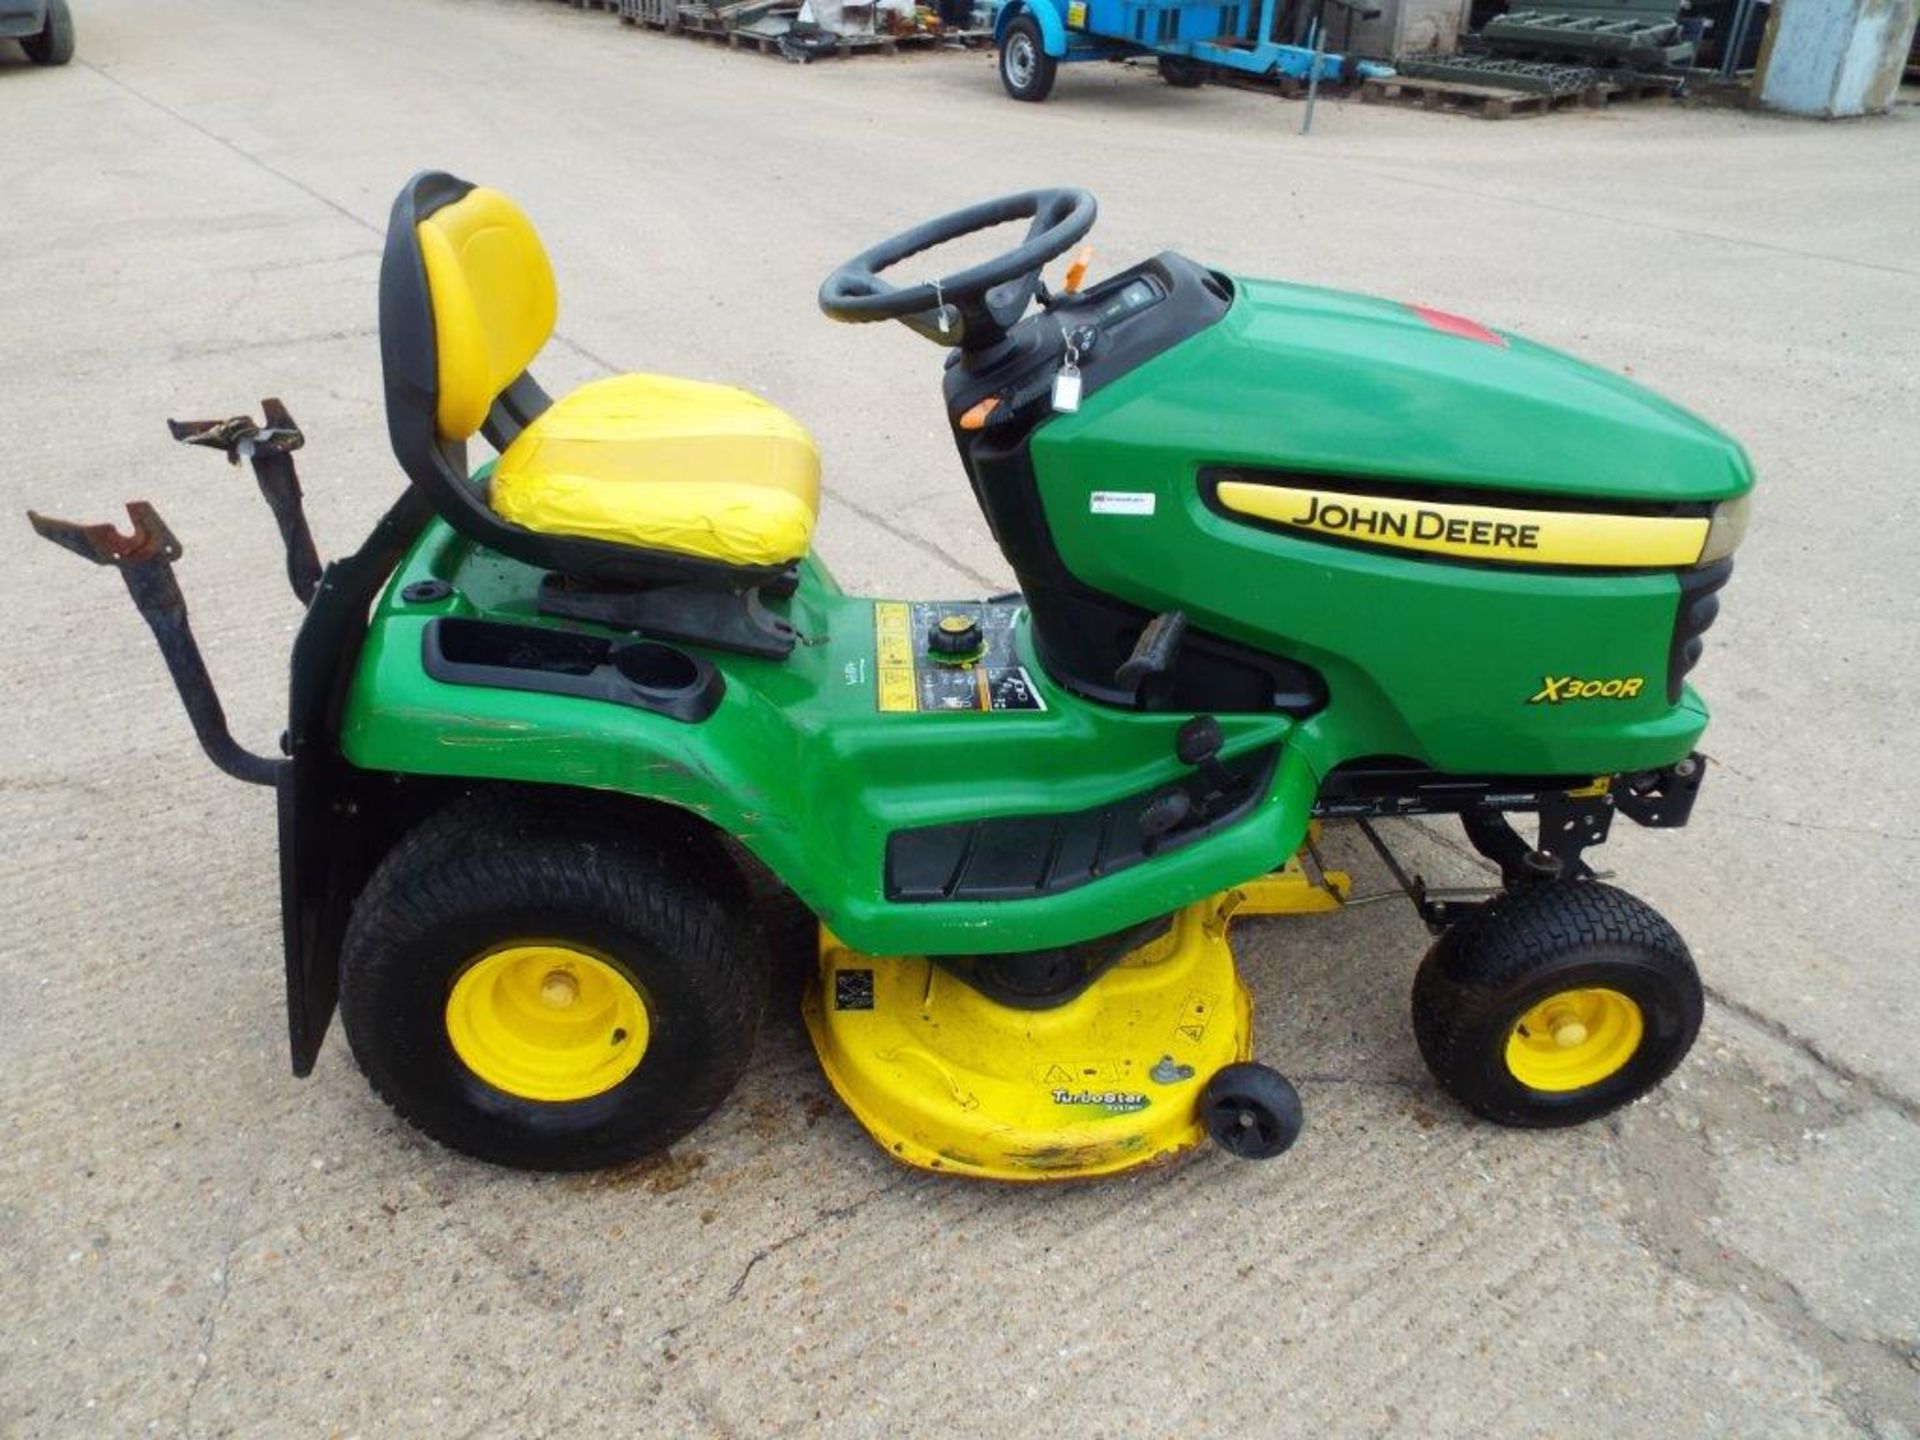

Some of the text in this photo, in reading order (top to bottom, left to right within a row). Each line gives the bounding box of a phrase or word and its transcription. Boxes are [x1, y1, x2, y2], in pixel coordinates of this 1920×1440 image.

[1292, 497, 1540, 549] JOHN DEERE
[1529, 676, 1644, 702] X300R
